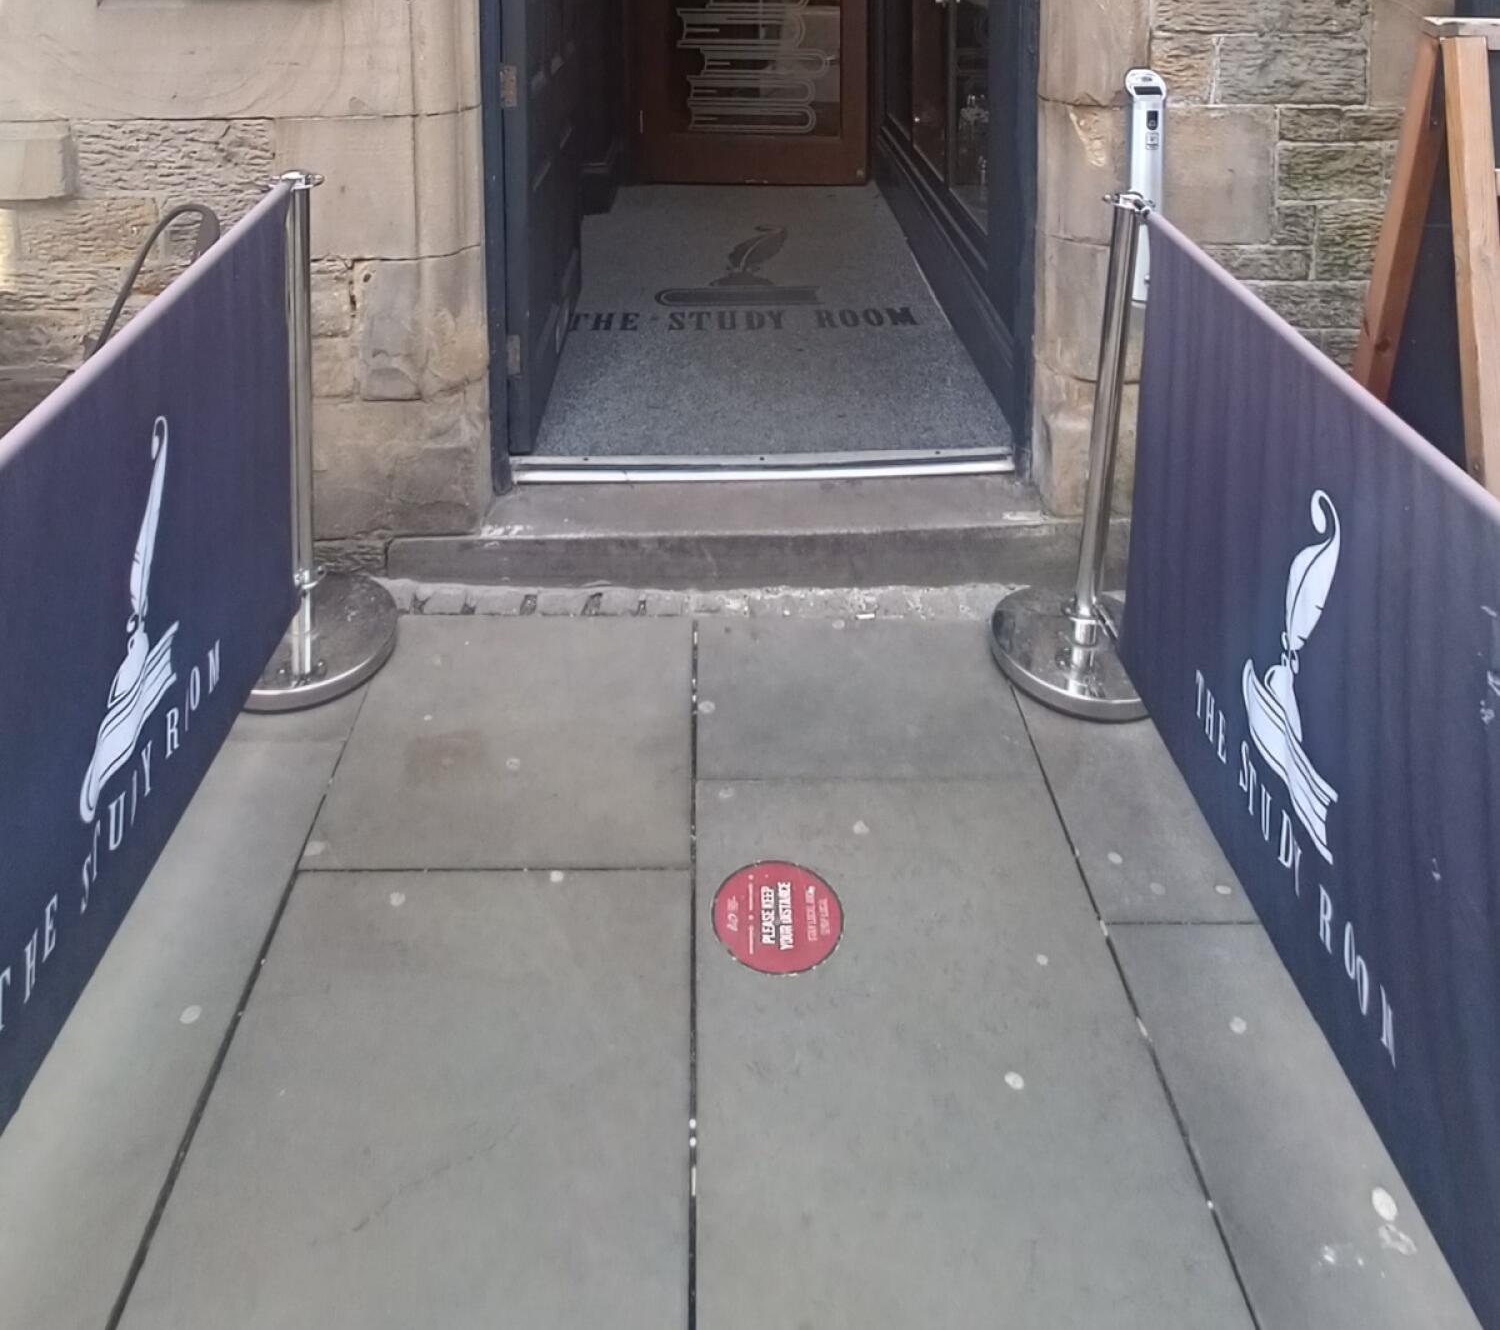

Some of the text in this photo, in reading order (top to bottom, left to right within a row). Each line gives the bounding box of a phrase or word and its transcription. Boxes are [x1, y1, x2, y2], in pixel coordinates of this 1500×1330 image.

[568, 306, 921, 331] THE STUDY ROOM
[165, 638, 221, 760] ROM
[1195, 669, 1227, 765] THE
[1239, 740, 1302, 898] STUDY
[760, 885, 776, 944] PLEASE KEEP
[777, 881, 794, 950] YOUR DISTANCE
